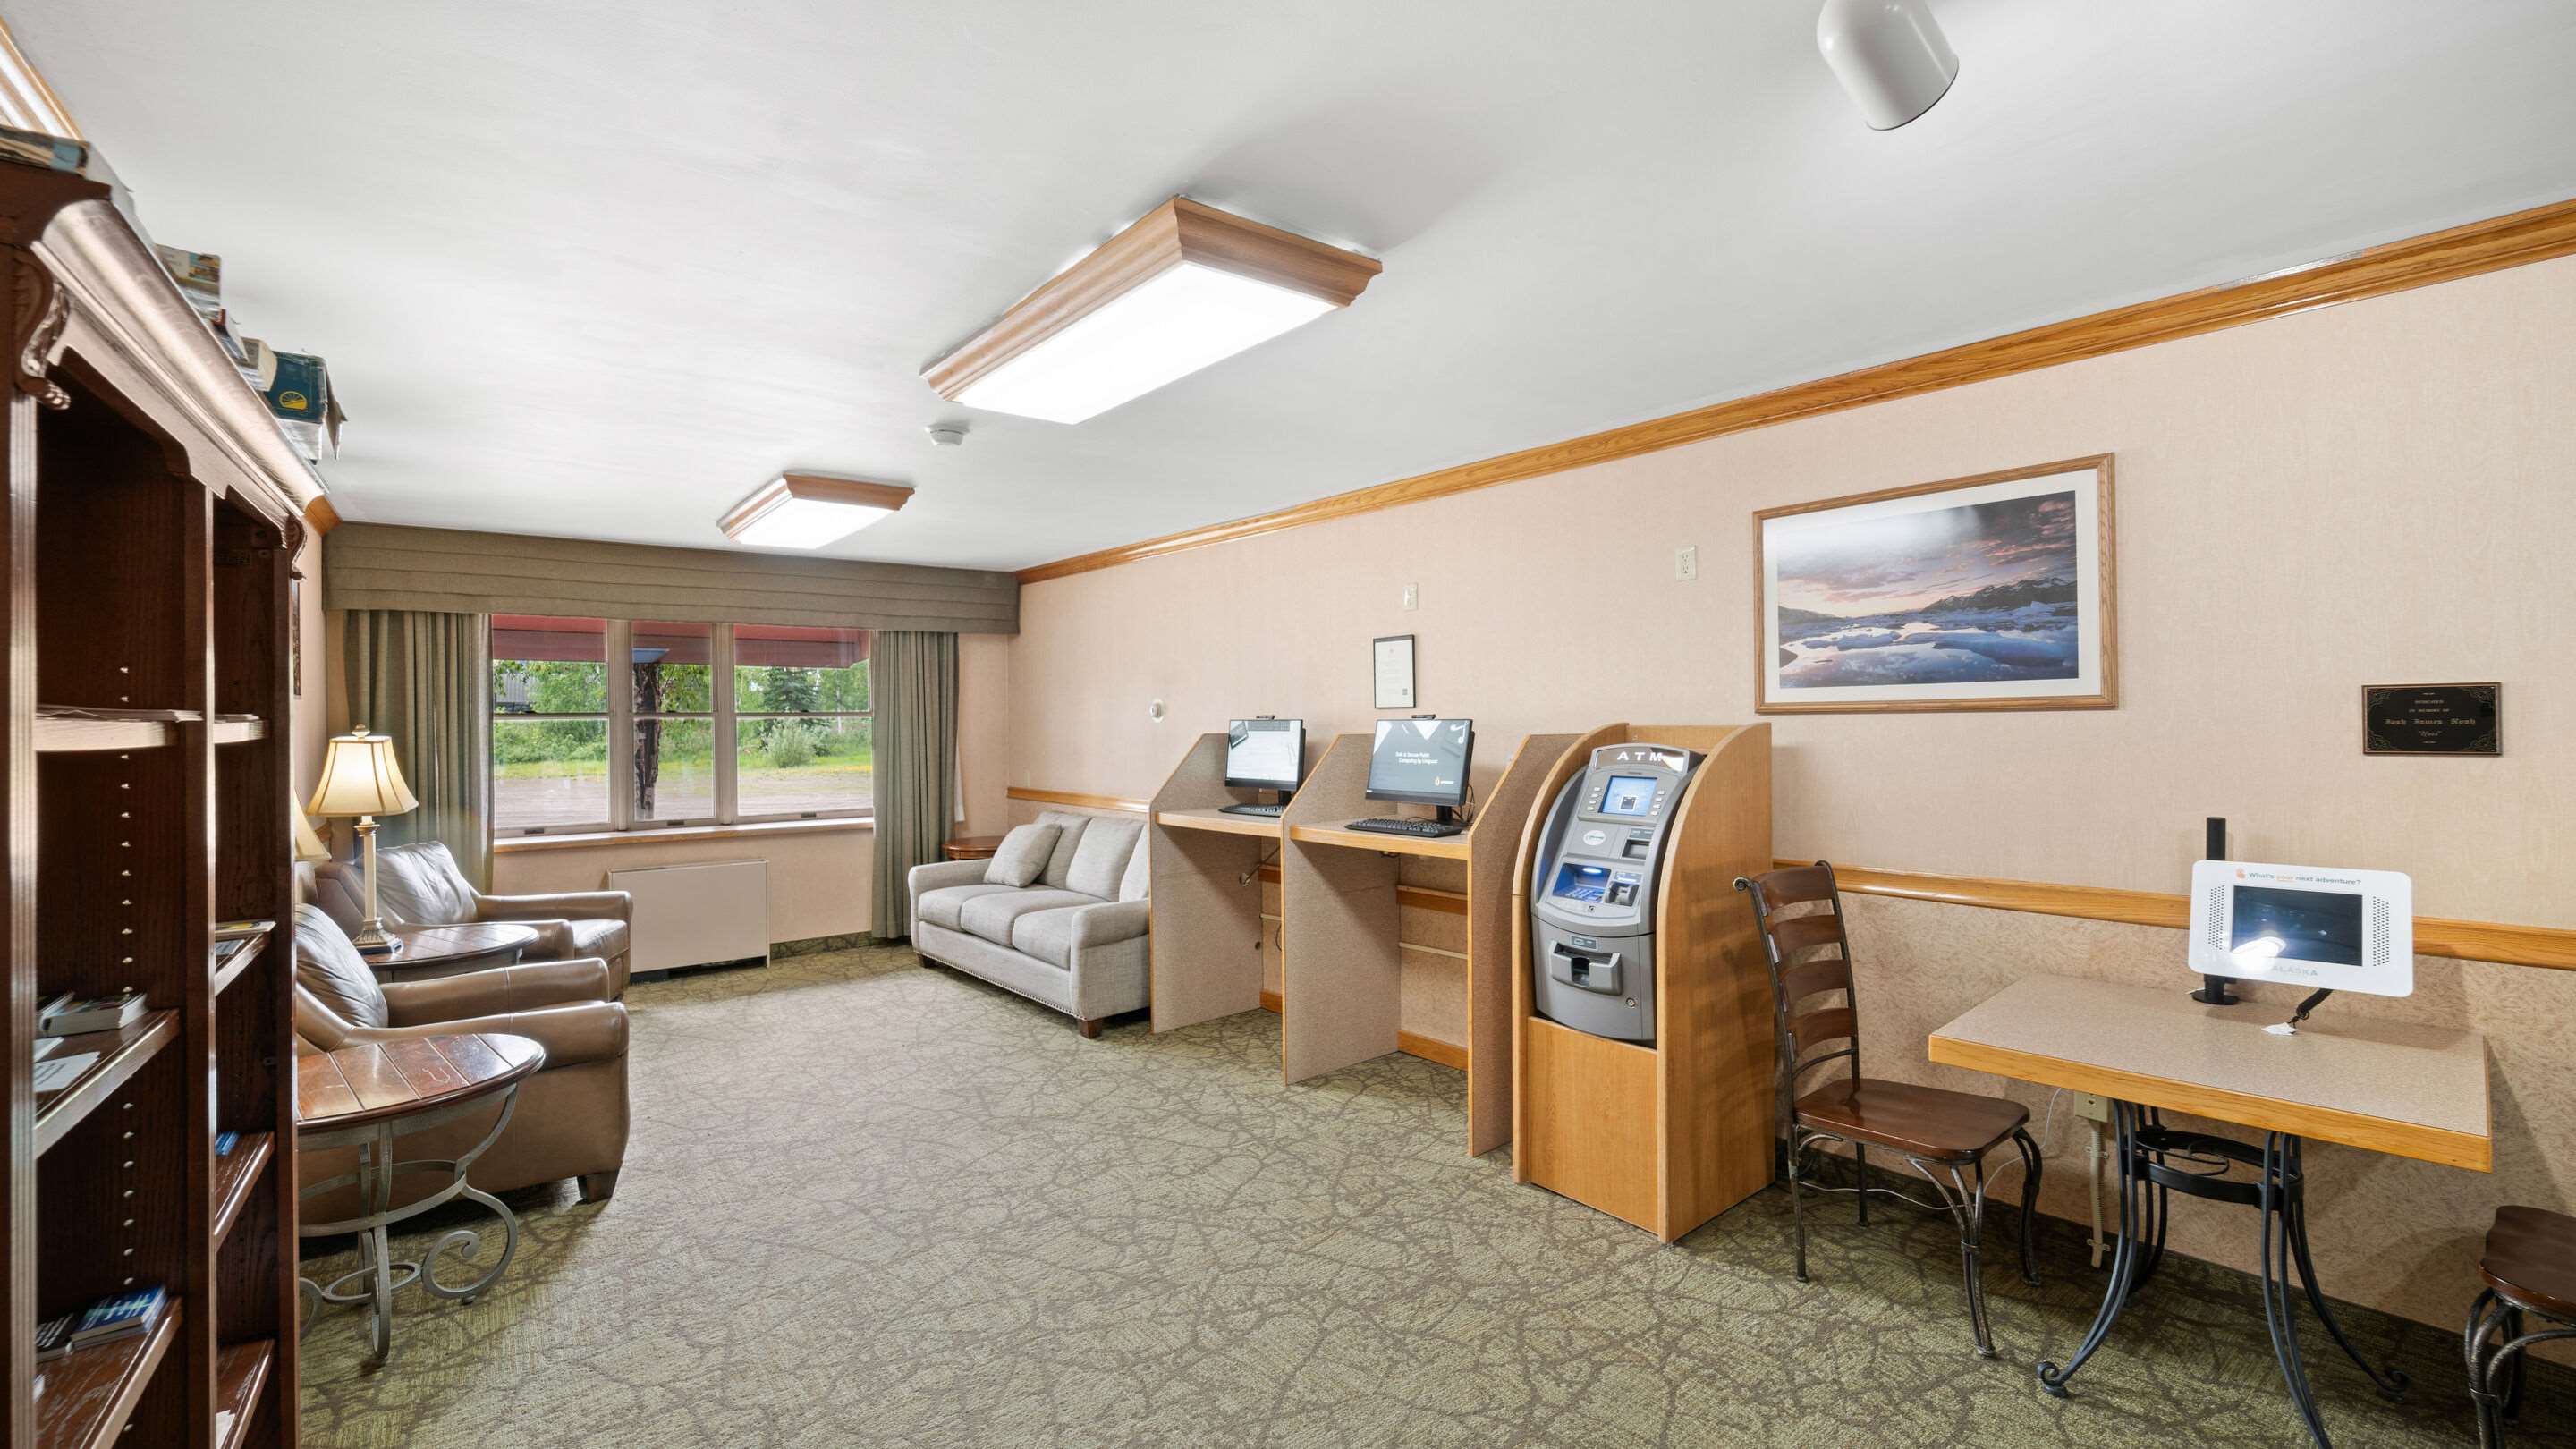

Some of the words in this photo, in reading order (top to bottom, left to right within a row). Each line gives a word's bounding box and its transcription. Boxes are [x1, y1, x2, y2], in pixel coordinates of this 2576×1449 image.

[1616, 750, 1663, 762] ATM
[2248, 872, 2275, 880] What's
[2295, 875, 2314, 883] next
[2315, 877, 2362, 886] adventure?
[2272, 964, 2318, 976] ALASKA
